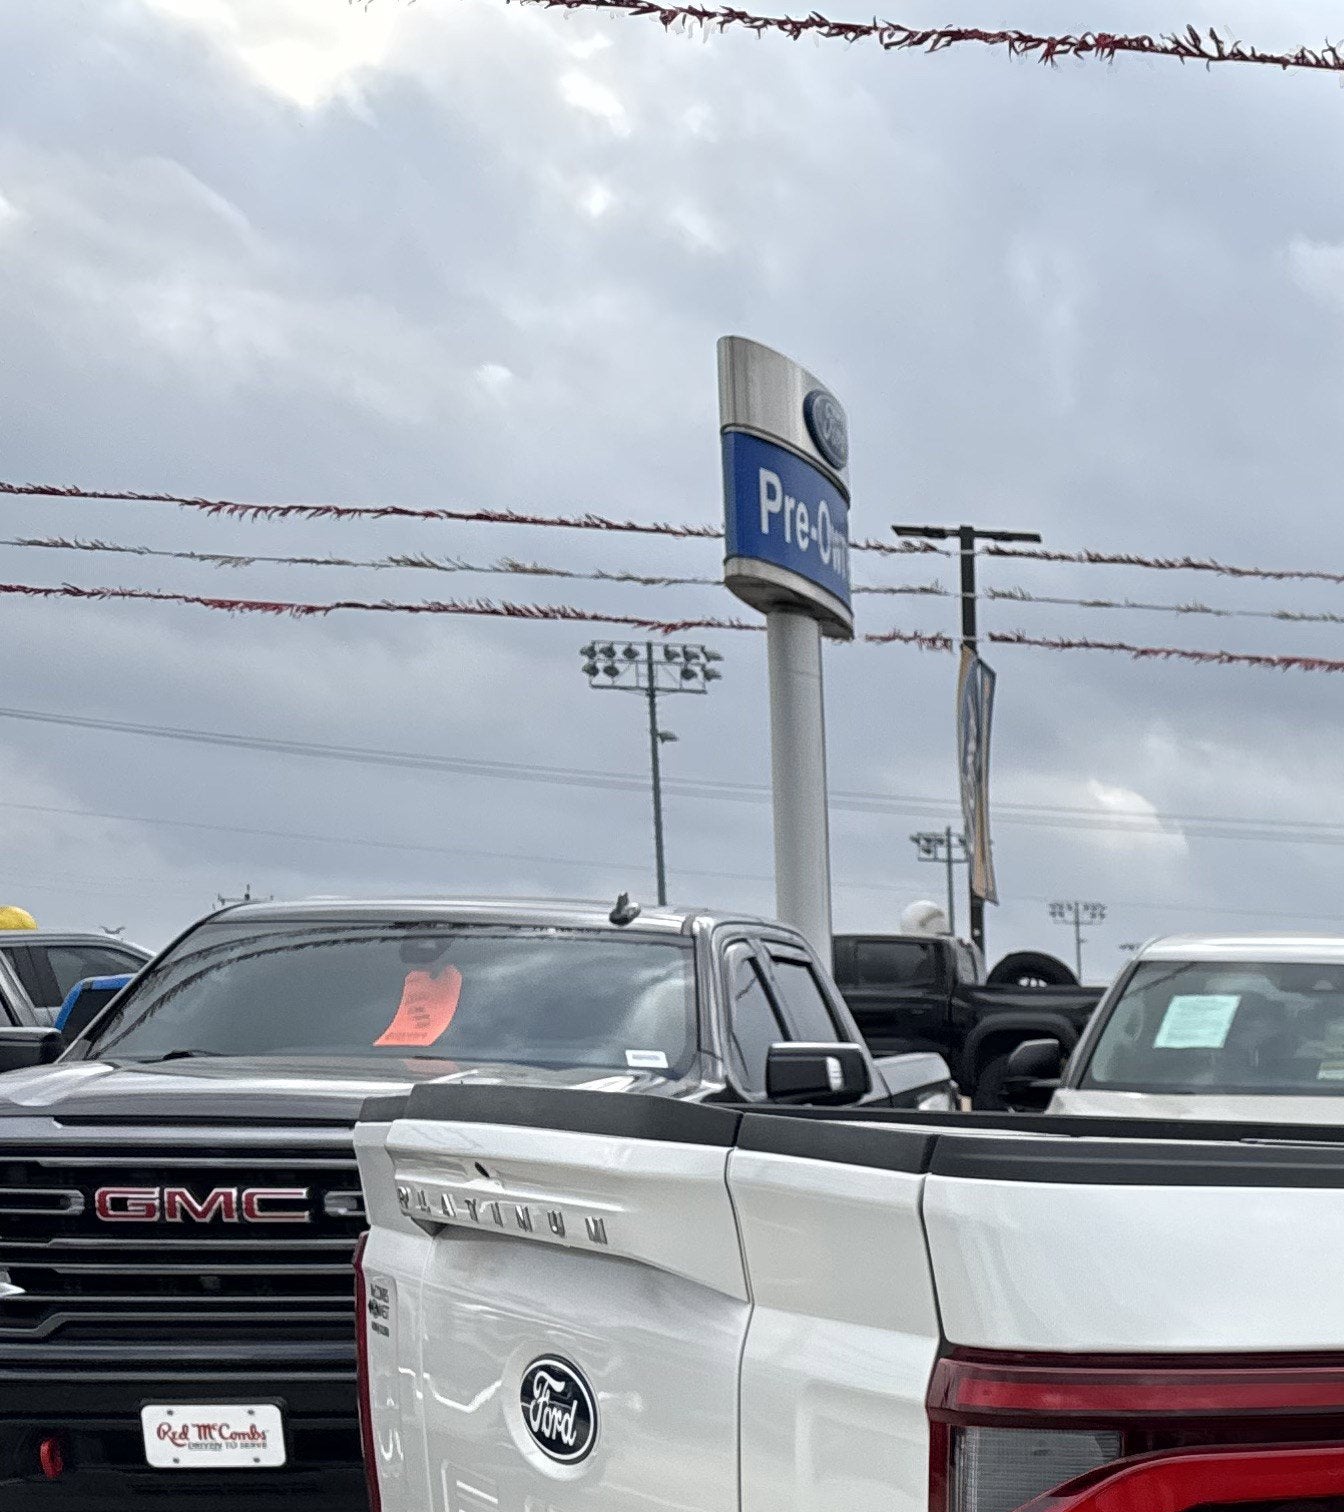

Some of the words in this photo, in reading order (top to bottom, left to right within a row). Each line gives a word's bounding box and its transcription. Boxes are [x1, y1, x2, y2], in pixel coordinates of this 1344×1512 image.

[95, 1187, 309, 1223] GMC
[397, 1186, 608, 1245] PLATINUM
[530, 1370, 578, 1446] Ford
[157, 1422, 189, 1447] Red
[191, 1422, 267, 1441] McCombs
